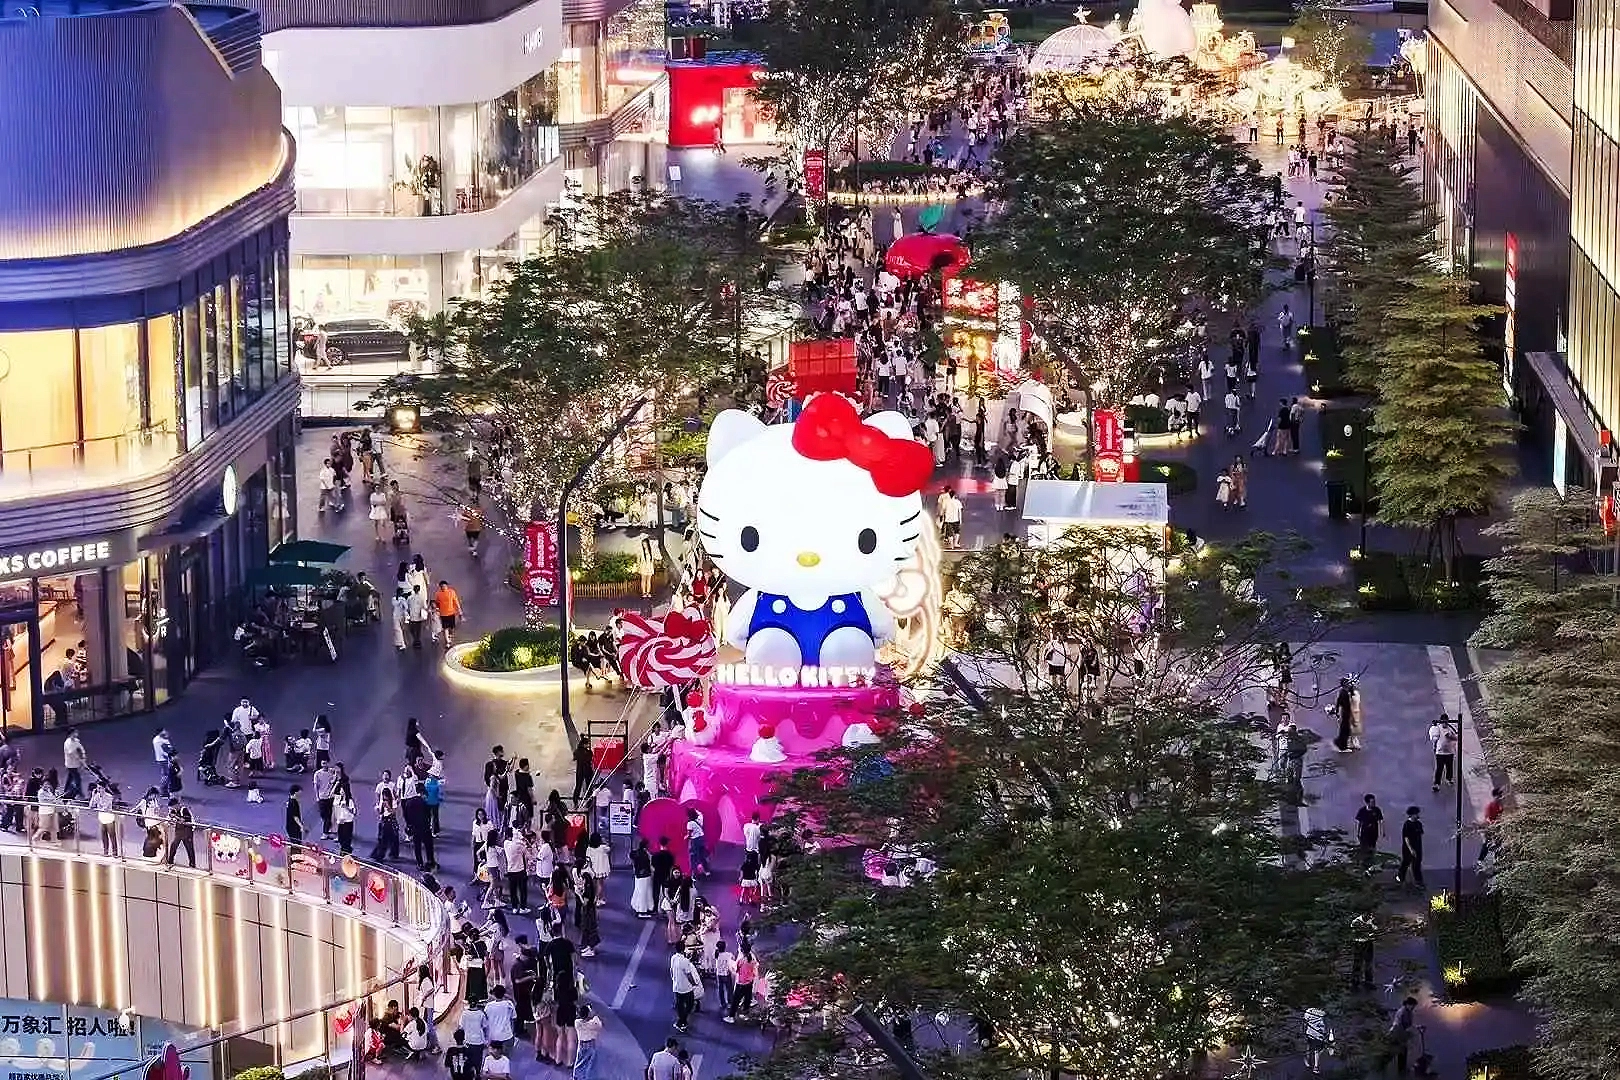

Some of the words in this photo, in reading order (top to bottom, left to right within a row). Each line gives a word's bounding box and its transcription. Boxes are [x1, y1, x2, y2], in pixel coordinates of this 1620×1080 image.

[27, 541, 110, 570] COFFEE
[717, 664, 799, 687] HELLO
[800, 665, 877, 687] KITTY
